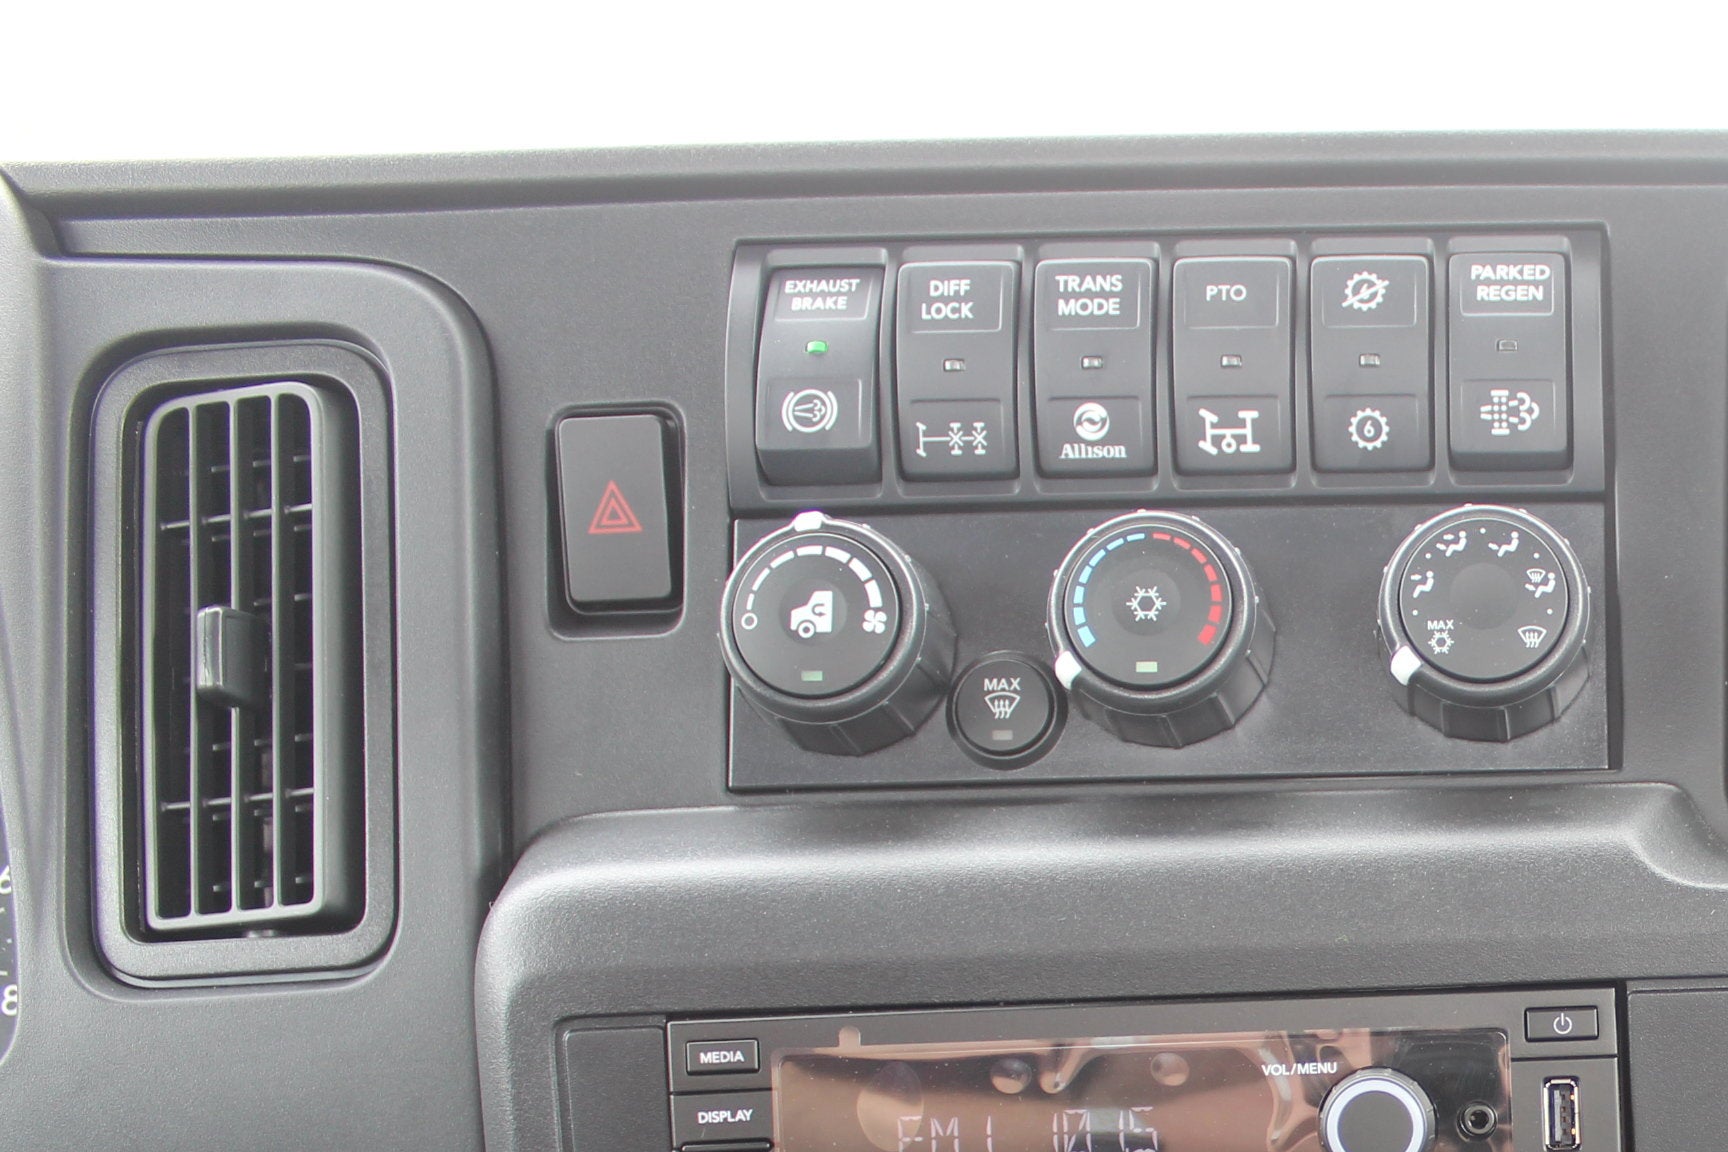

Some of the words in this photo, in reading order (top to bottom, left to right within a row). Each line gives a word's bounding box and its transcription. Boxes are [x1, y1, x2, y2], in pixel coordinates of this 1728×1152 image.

[1471, 265, 1550, 280] PARKED
[784, 278, 860, 294] EXHAUST
[930, 280, 970, 296] DIFF
[1056, 275, 1122, 292] TRANS
[1207, 285, 1246, 300] PTO
[1477, 285, 1543, 300] REGEN
[791, 296, 847, 311] BRAKE
[922, 302, 973, 319] LOCK
[1058, 298, 1120, 315] MODE
[1364, 420, 1374, 437] 6
[1061, 444, 1126, 458] Allison
[1427, 619, 1454, 630] MAX
[983, 677, 1021, 691] MAX
[700, 1051, 744, 1063] MEDIA
[1261, 1062, 1338, 1077] VOL/MENU
[697, 1109, 753, 1124] DISPLAY
